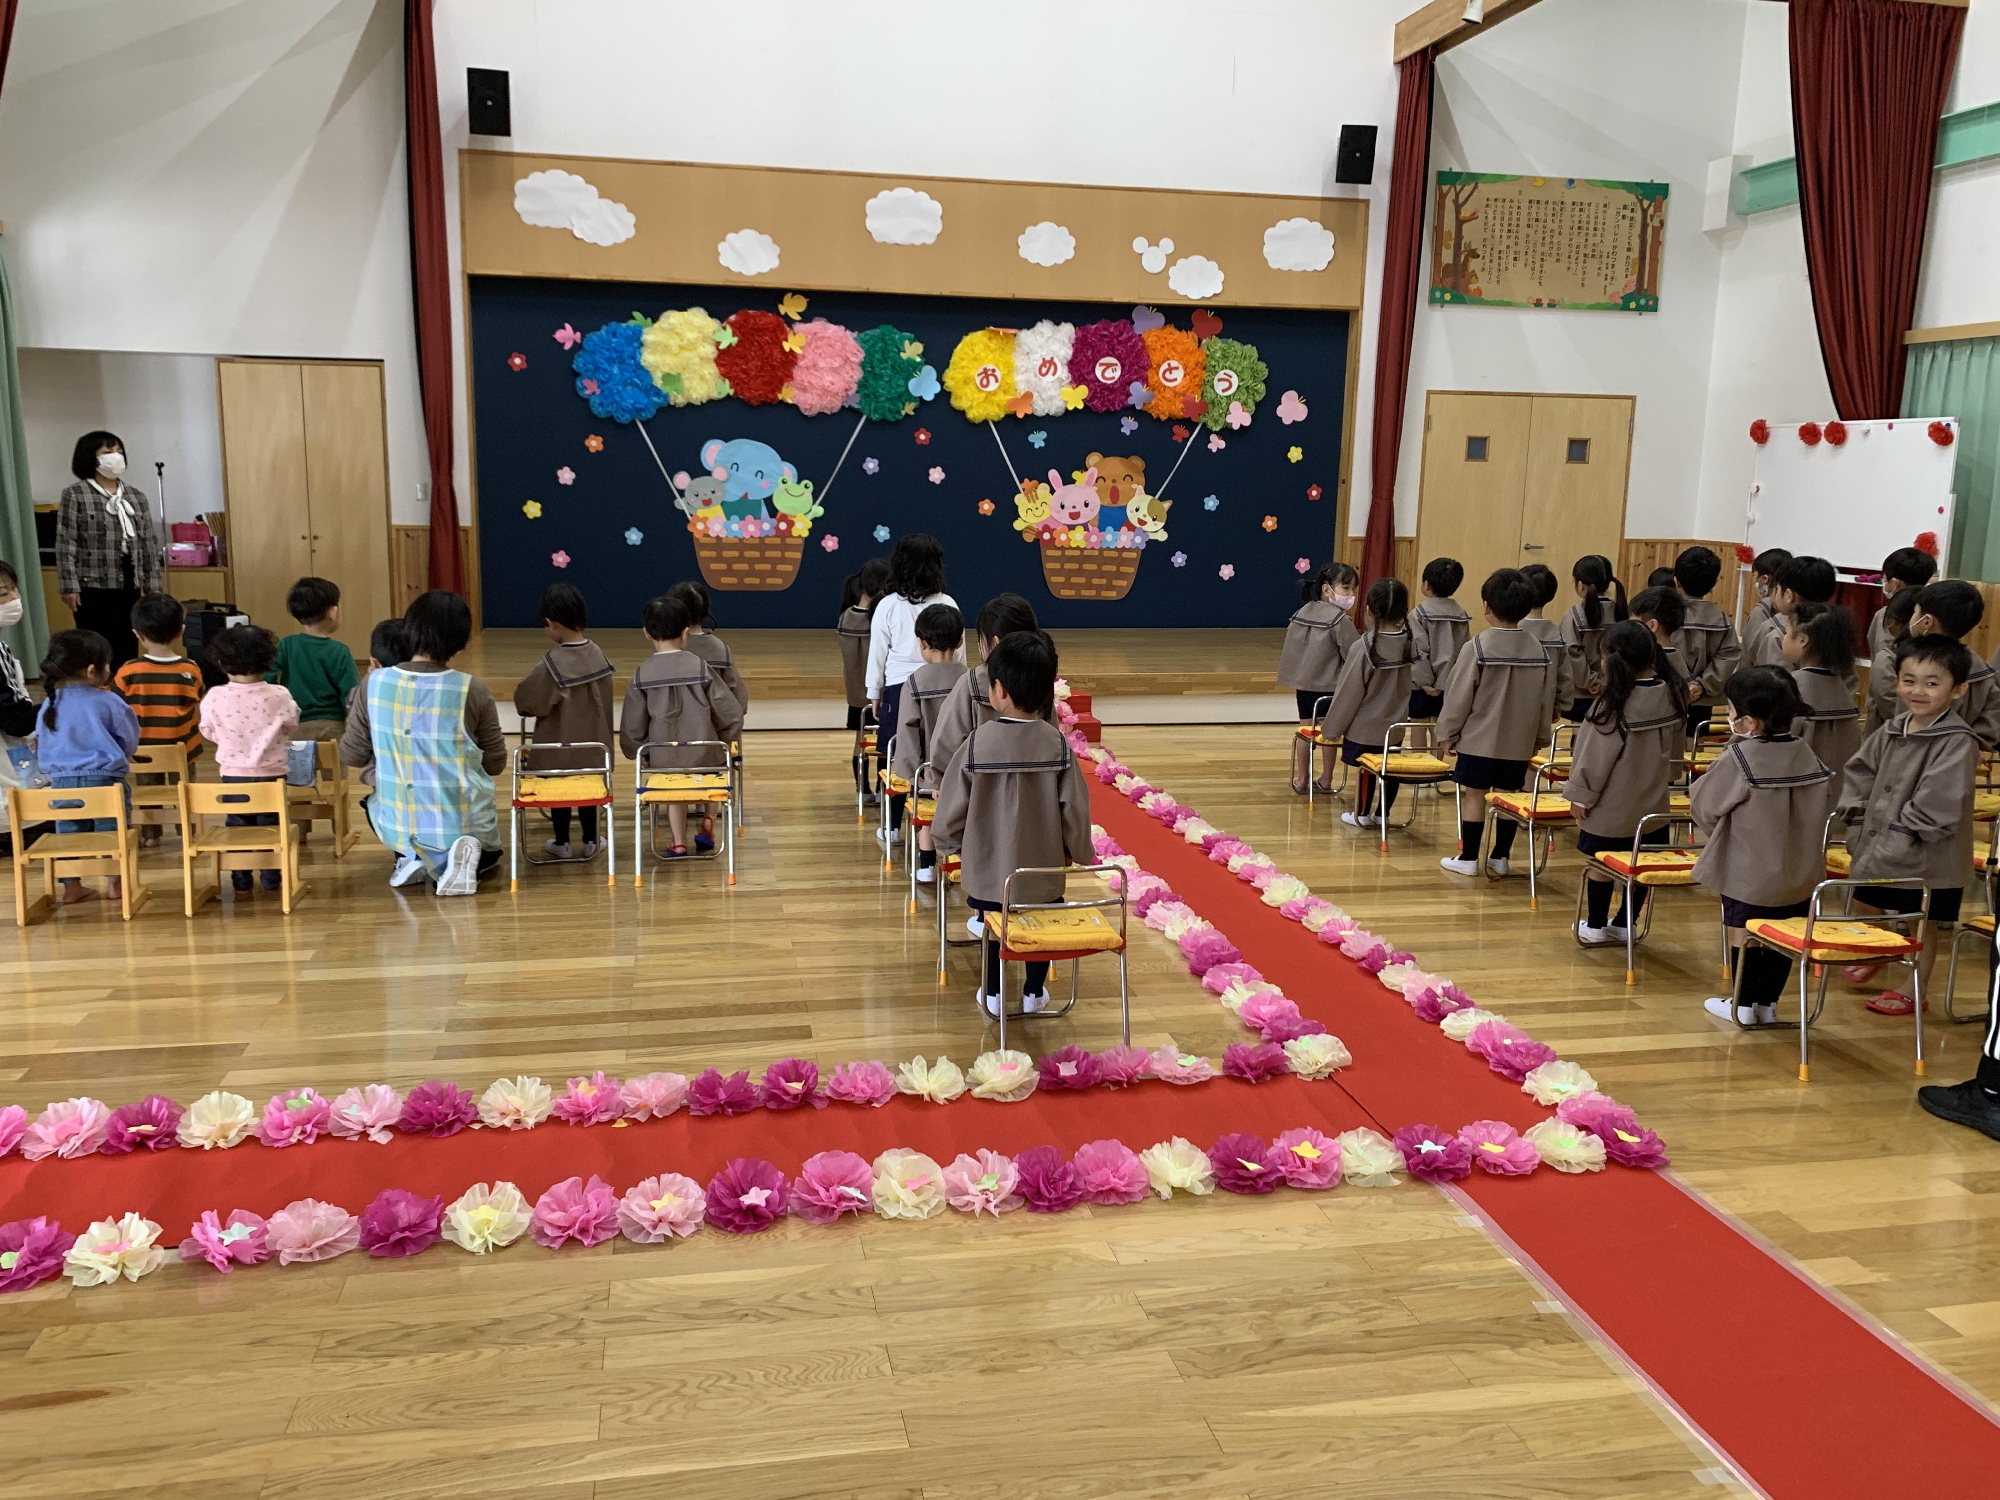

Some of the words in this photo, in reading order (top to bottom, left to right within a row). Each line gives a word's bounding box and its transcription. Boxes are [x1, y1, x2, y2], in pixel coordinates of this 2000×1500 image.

[976, 356, 1234, 394] おめでとう
